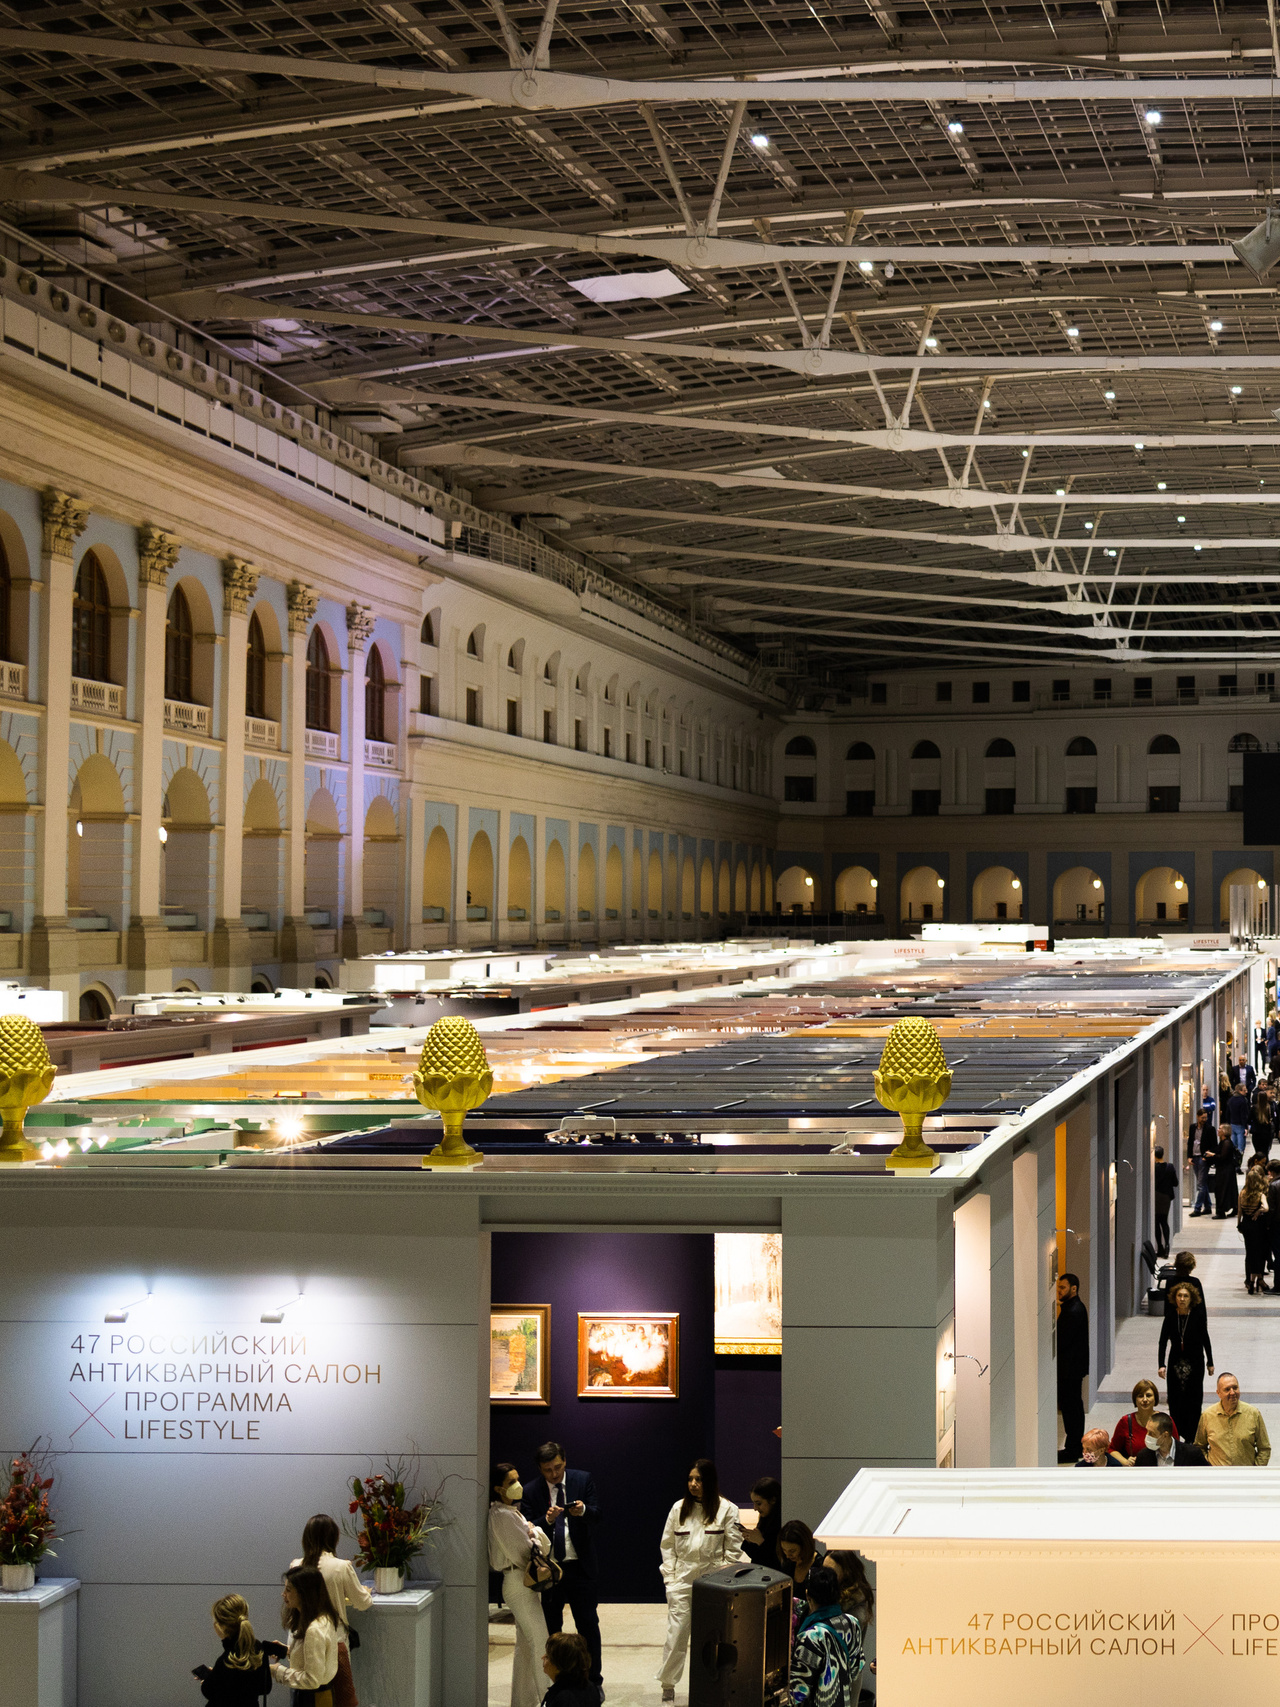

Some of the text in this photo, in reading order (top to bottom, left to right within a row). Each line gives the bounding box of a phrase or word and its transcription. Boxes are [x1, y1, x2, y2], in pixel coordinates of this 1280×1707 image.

[70, 1330, 307, 1355] 47 РОССИЙСКИЙ
[69, 1359, 381, 1384] АНТИКВАРНЫЙ САЛОН
[125, 1391, 293, 1412] ПРОГРАММА
[124, 1419, 260, 1440] LIFESTYLE
[967, 1609, 1175, 1631] 47 РОССИЙСКИЙ
[901, 1633, 1175, 1656] АНТИКВАРНЫЙ САЛОН
